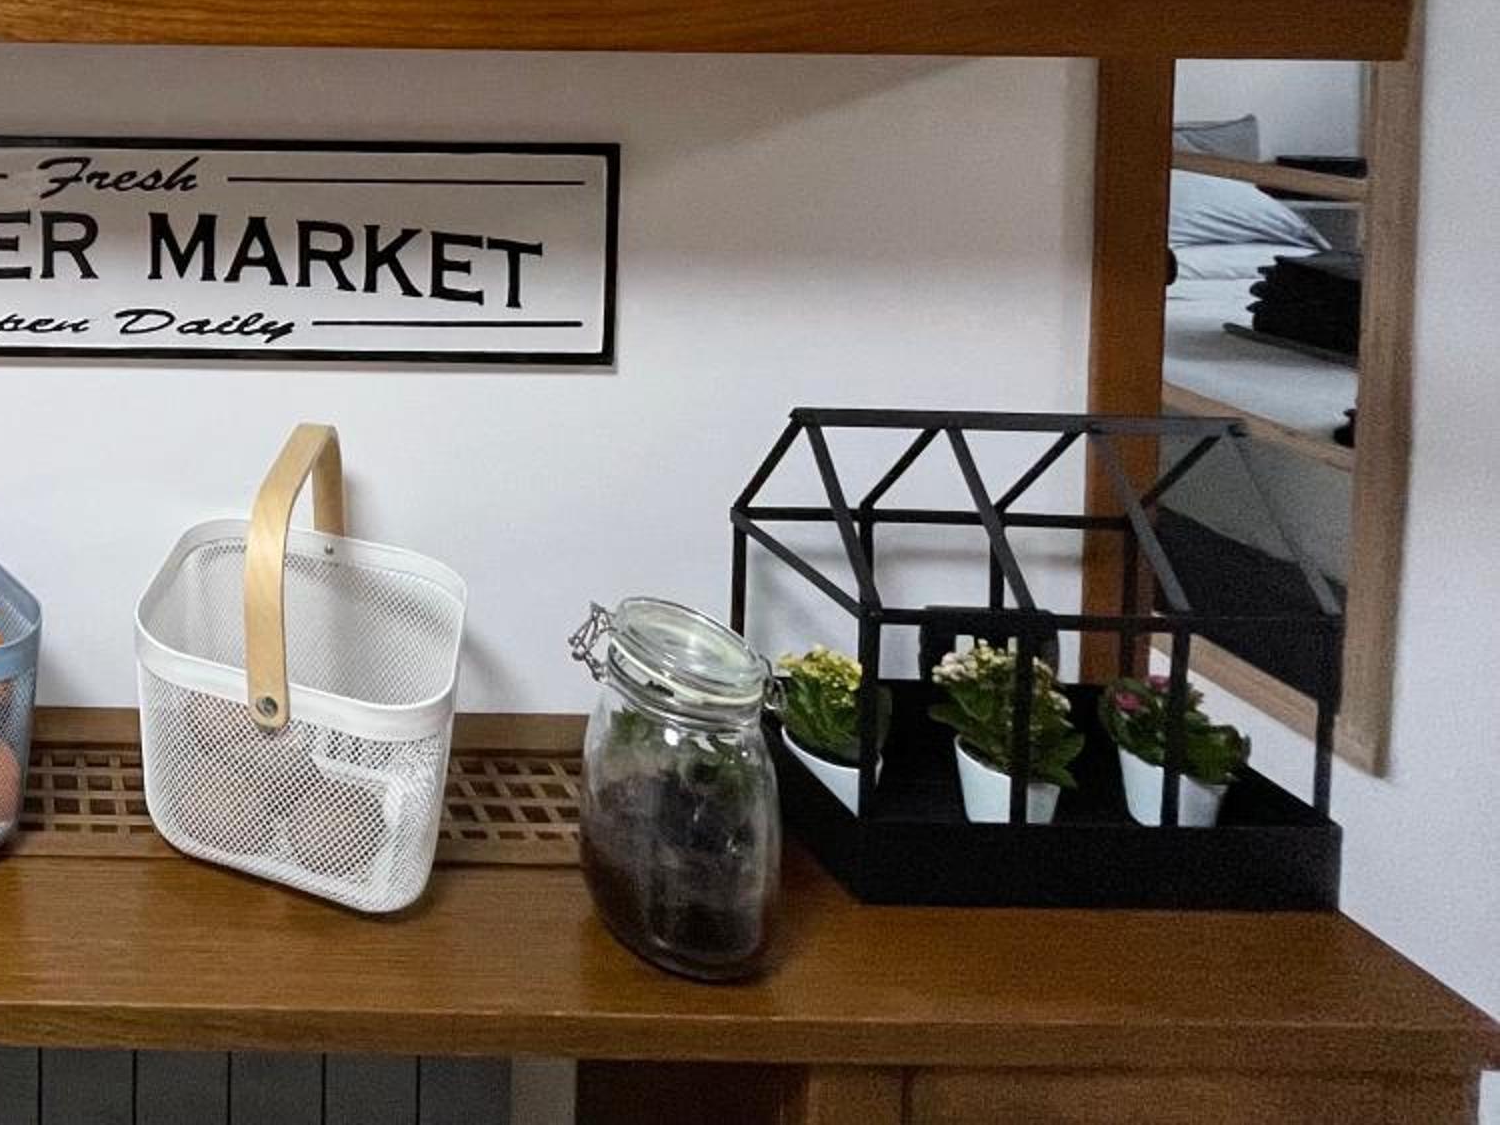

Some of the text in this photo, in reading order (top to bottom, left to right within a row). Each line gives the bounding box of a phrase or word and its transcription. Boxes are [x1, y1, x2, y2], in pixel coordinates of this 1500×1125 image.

[36, 155, 200, 200] Fresh
[147, 211, 544, 309] MARKET
[114, 308, 296, 344] Daily
